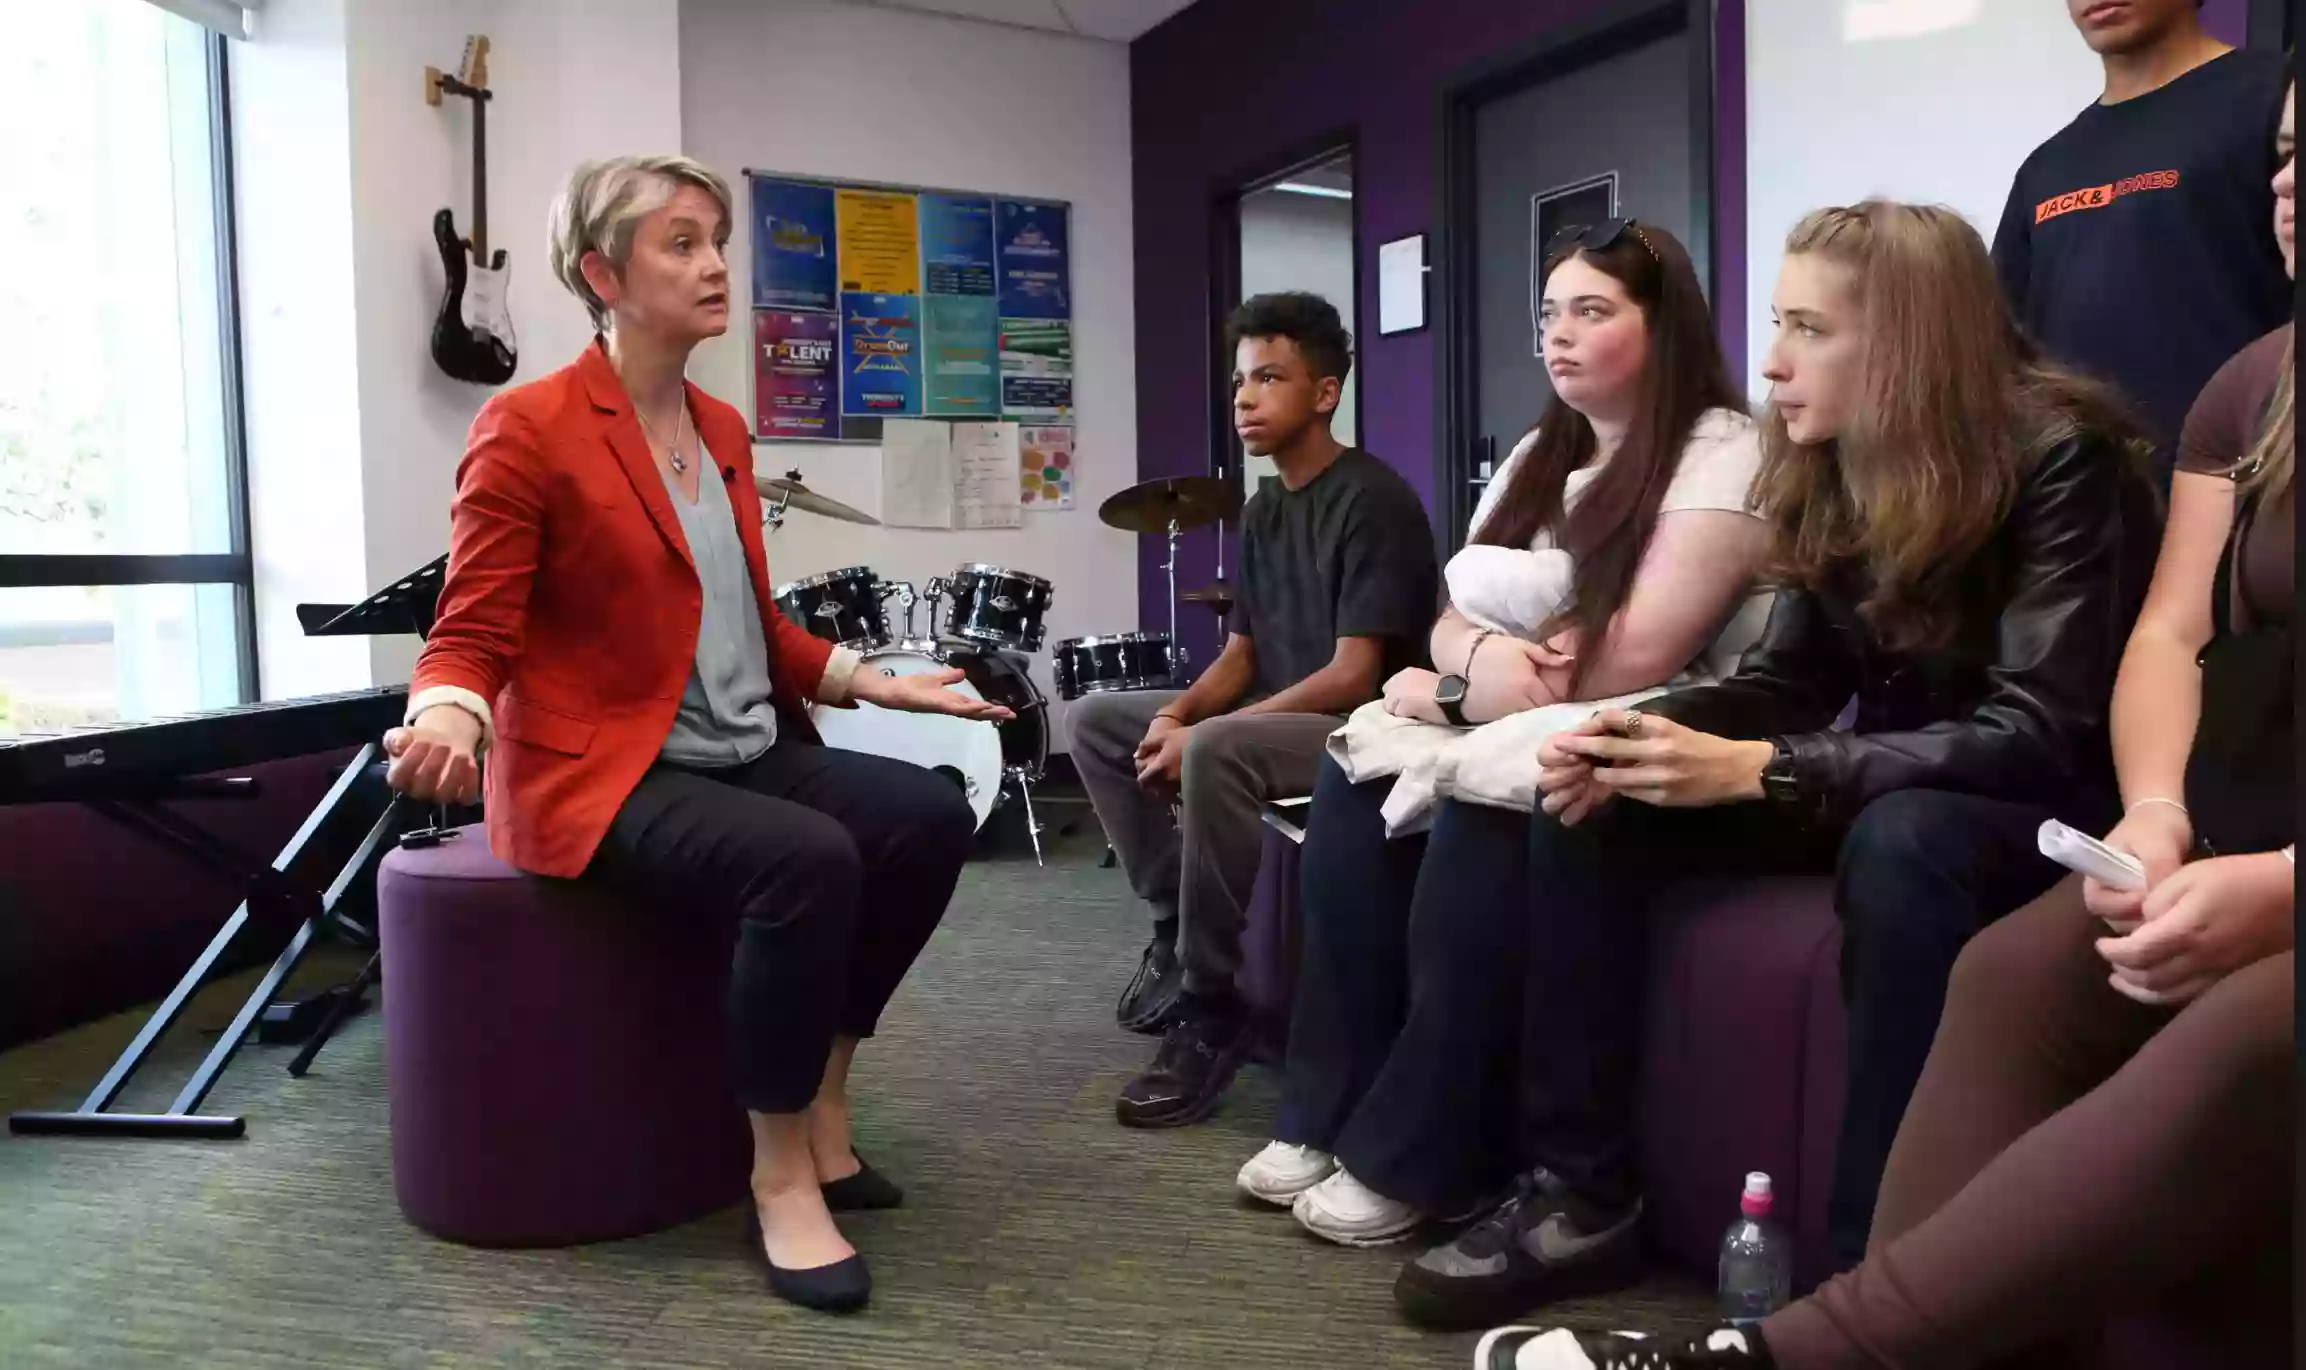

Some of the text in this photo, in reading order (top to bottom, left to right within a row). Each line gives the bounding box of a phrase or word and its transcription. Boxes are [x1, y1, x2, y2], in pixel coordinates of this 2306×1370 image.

[2040, 169, 2179, 218] JACK & JONES
